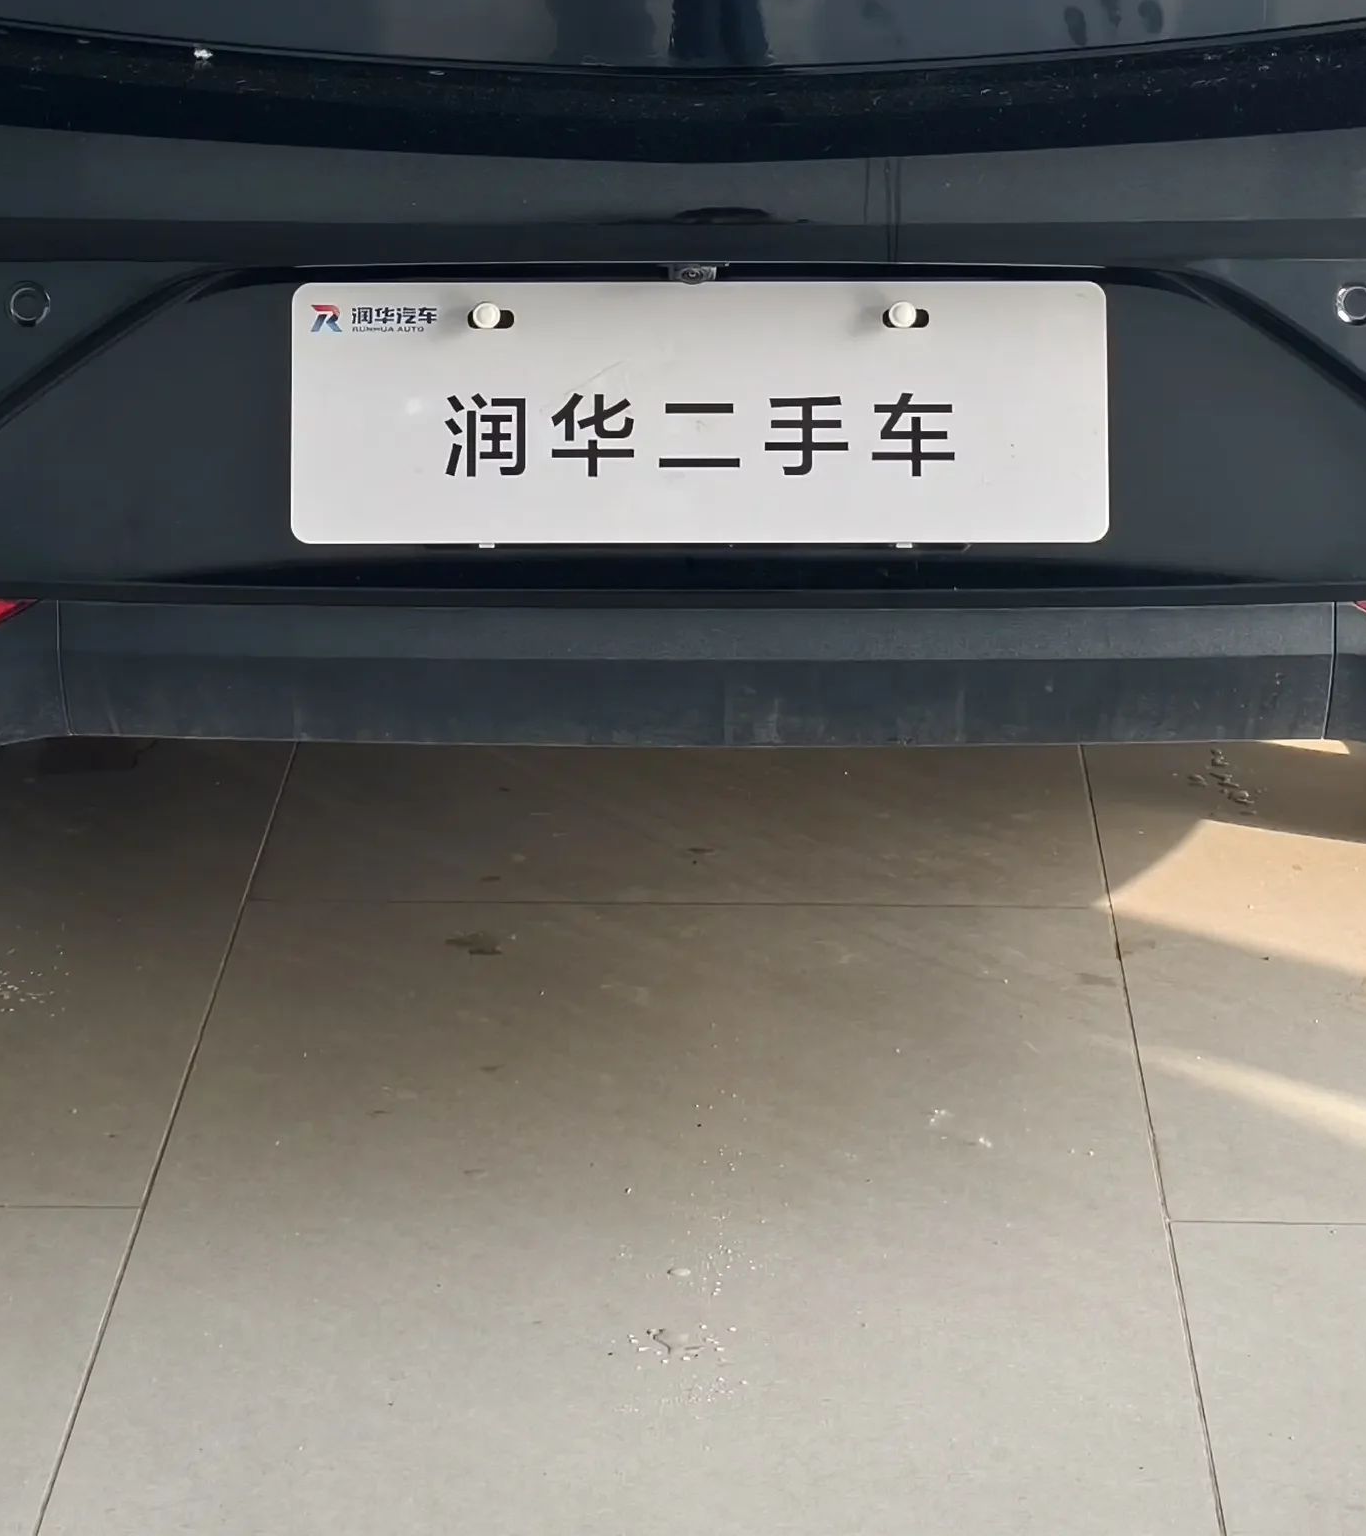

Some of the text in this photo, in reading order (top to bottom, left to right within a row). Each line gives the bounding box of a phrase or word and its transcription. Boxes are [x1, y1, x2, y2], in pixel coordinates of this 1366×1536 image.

[351, 306, 438, 325] 润华汽车
[396, 325, 425, 333] AUTO
[444, 392, 958, 479] 润华二手车
